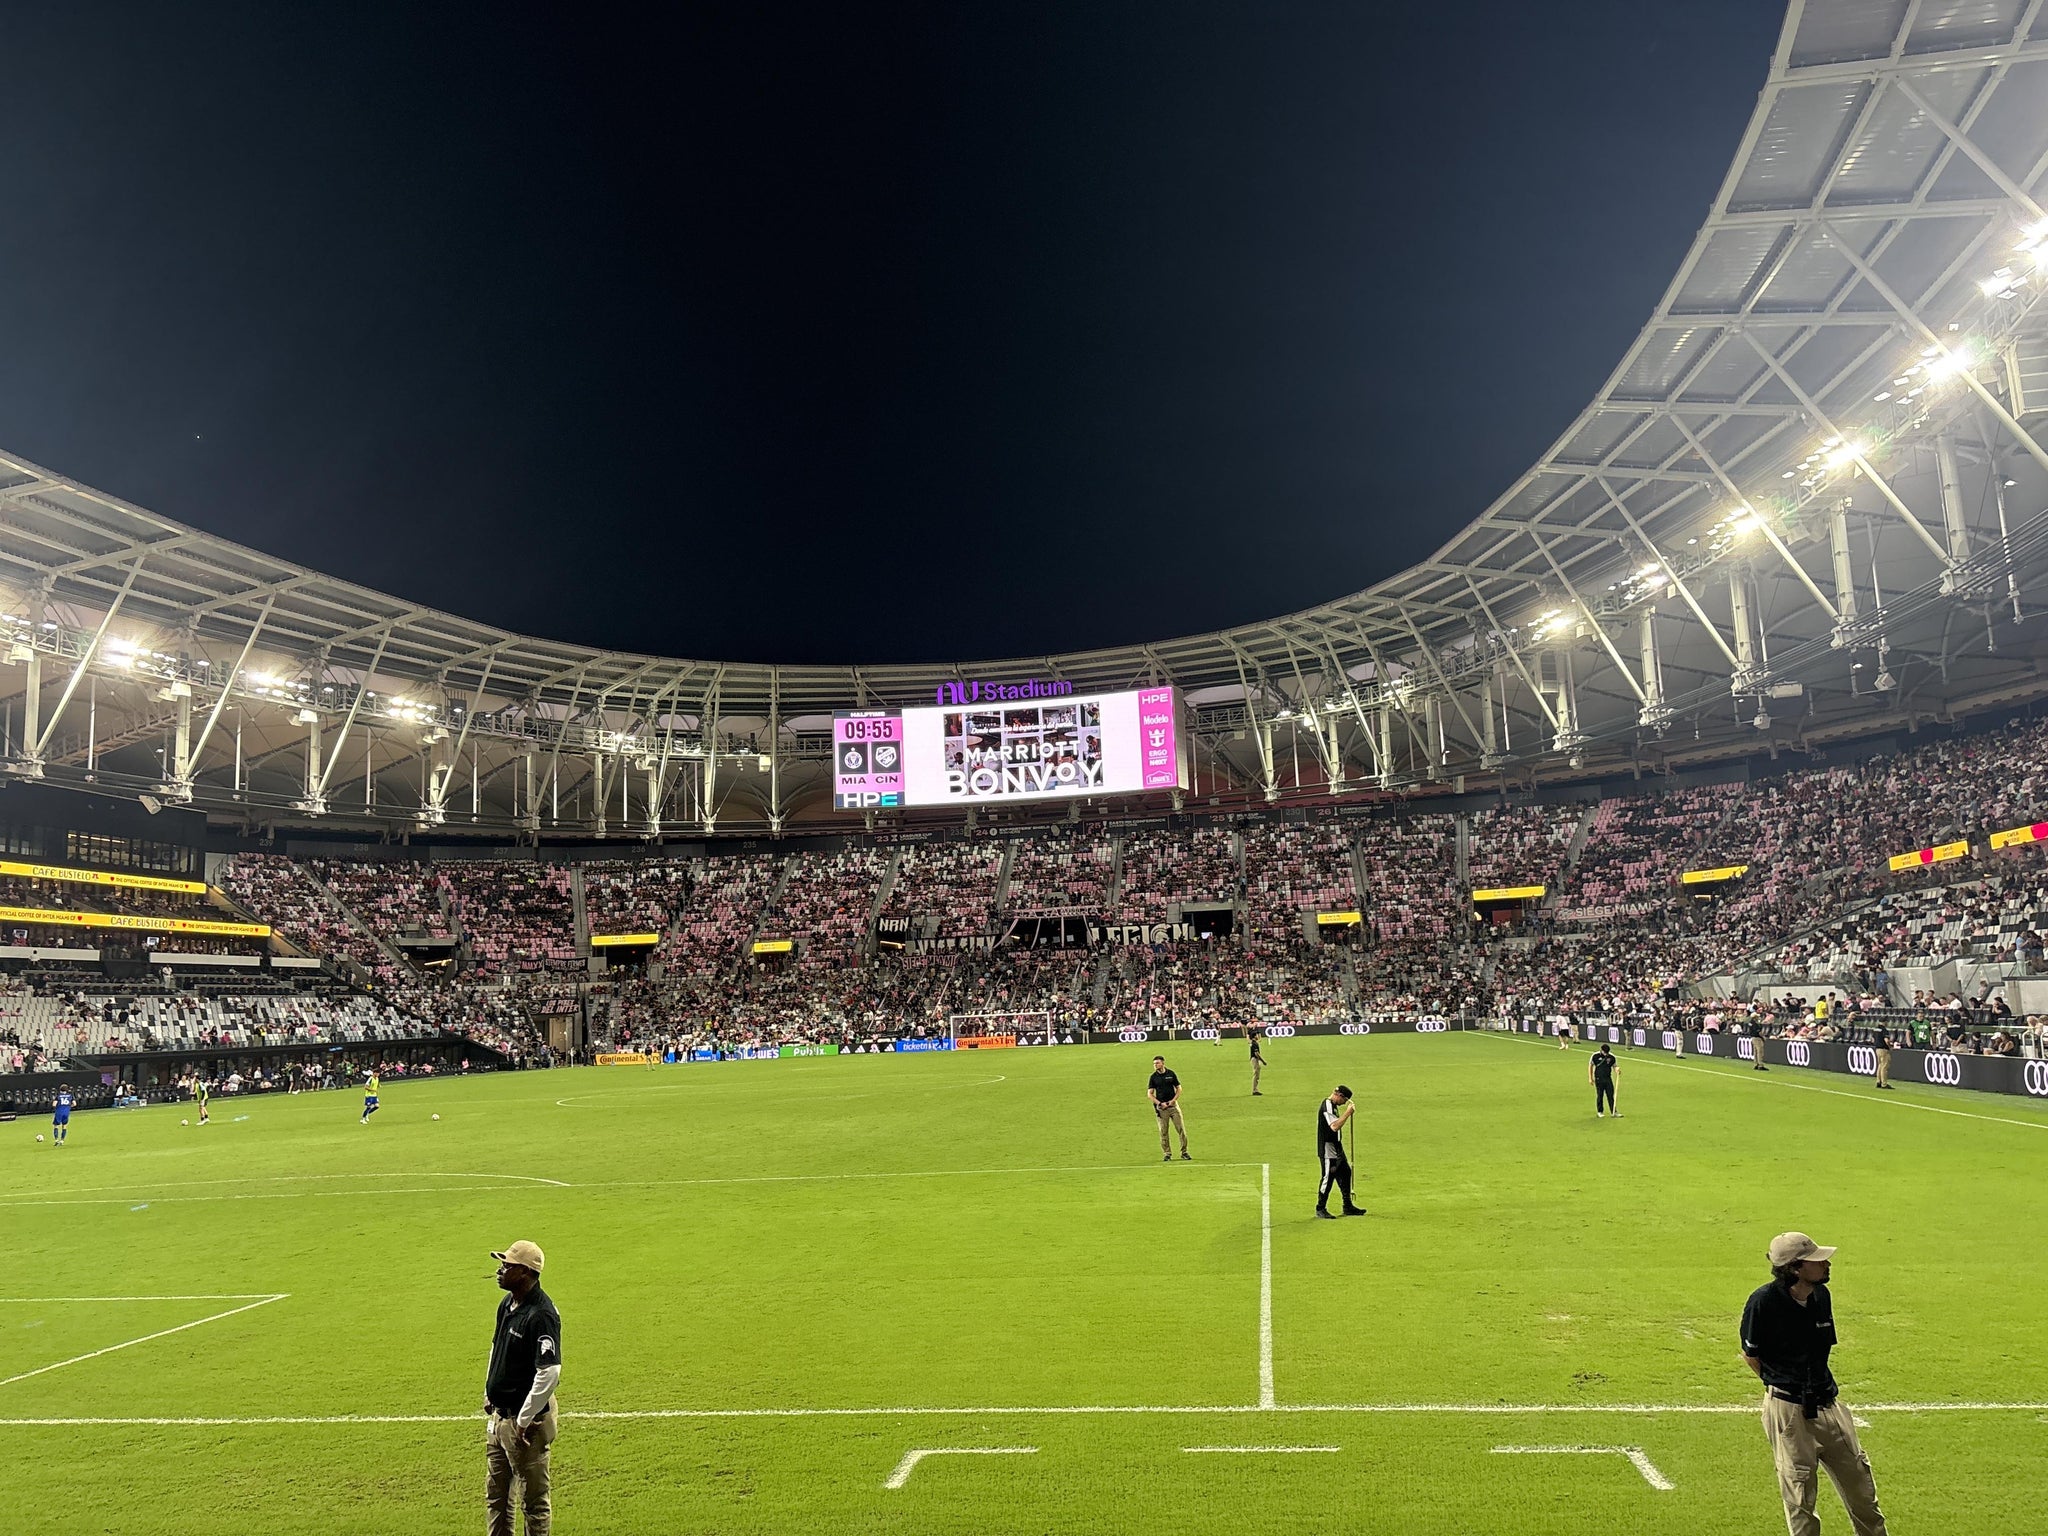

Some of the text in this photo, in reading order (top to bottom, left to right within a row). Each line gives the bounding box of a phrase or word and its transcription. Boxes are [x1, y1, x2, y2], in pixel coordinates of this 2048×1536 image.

[984, 679, 1073, 701] Stadium
[1141, 693, 1169, 705] HPE
[1143, 713, 1169, 725] Modelo
[845, 720, 893, 739] 09:55
[965, 740, 1081, 763] MARRIOTT
[1148, 749, 1168, 757] ERGO
[841, 776, 867, 785] MIA
[875, 775, 898, 784] CIN
[946, 759, 1103, 796] BONVOY
[843, 791, 898, 808] HPE
[259, 839, 273, 847] 239
[743, 841, 757, 849] 235
[58, 869, 91, 880] BUSTELO
[1575, 903, 1650, 917] SIEGE MIAMI
[136, 918, 168, 929] BUSTELO
[541, 1005, 579, 1014] DEL INTER
[957, 1037, 1015, 1048] Continental Tire
[599, 1055, 640, 1065] Continental
[60, 1097, 70, 1106] 16
